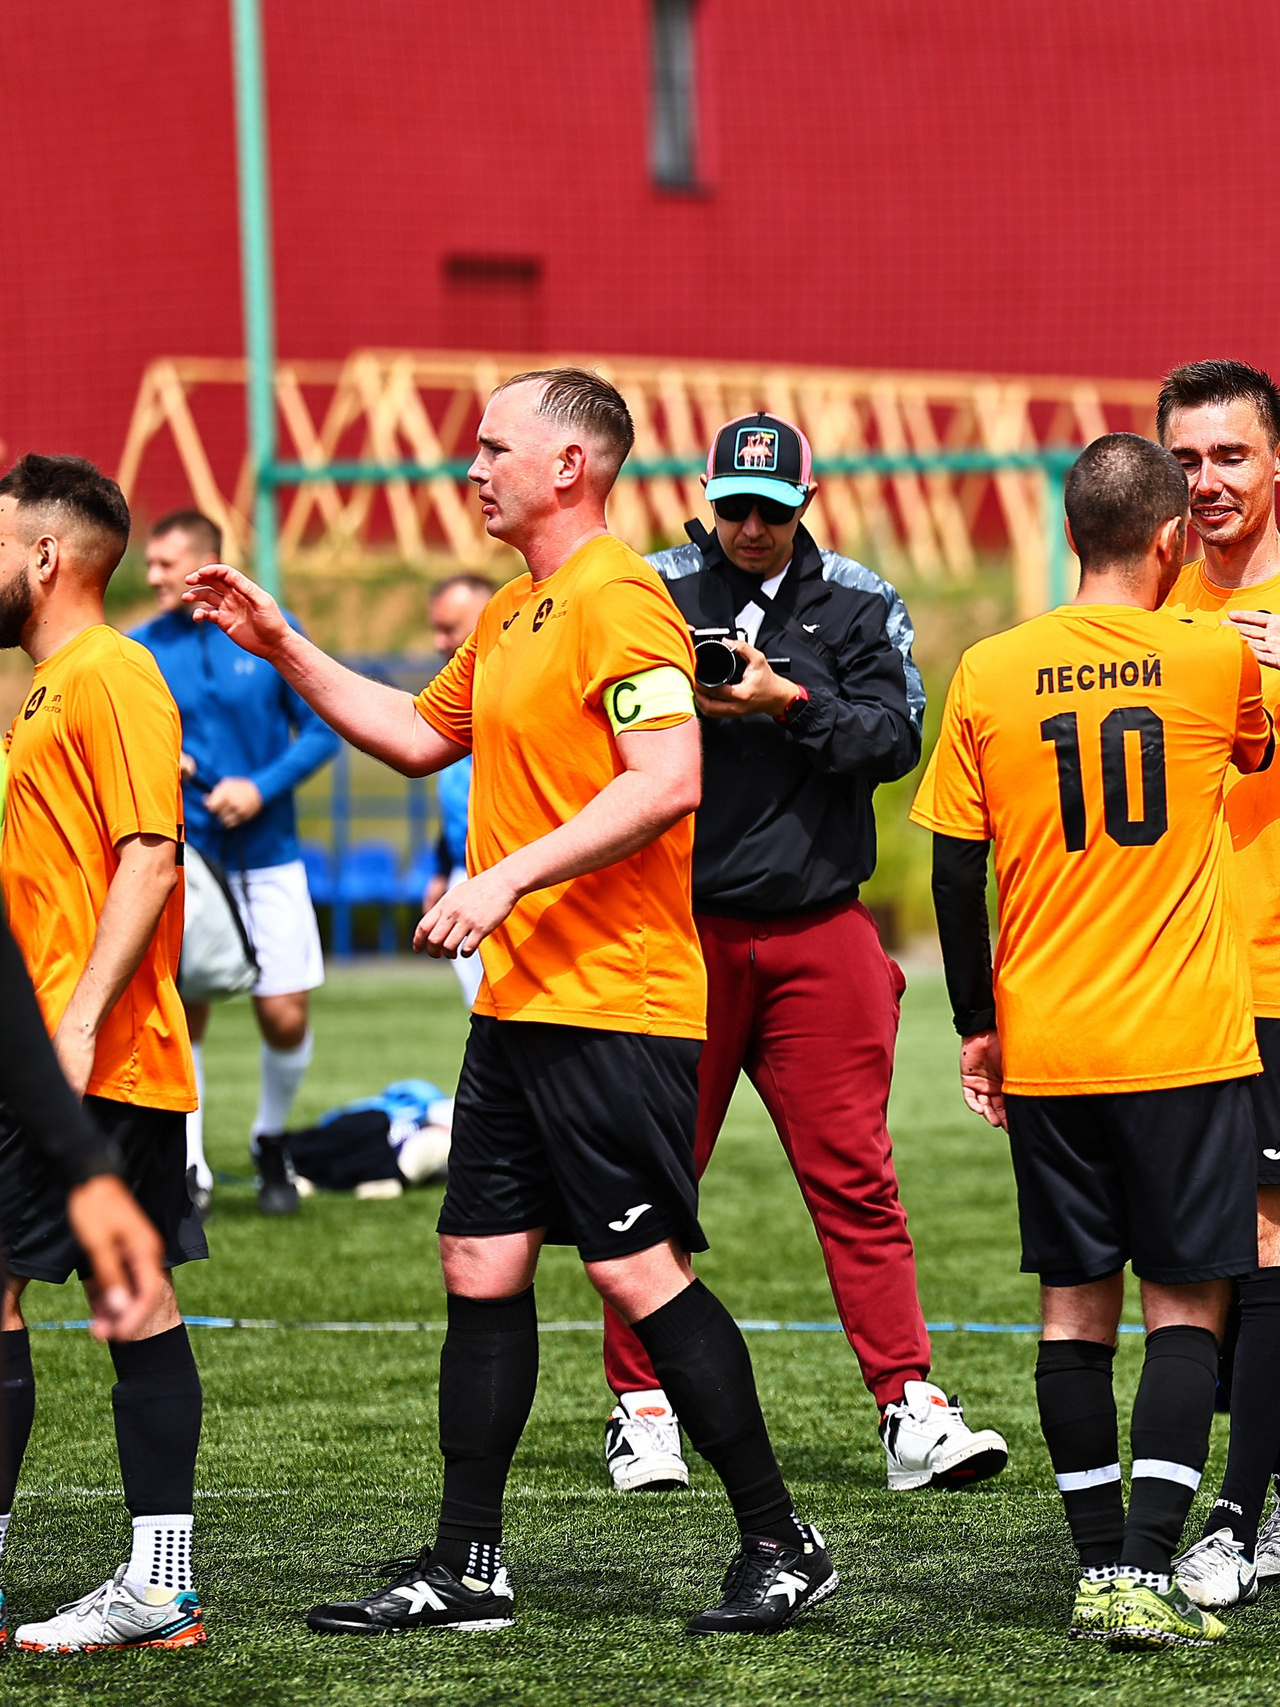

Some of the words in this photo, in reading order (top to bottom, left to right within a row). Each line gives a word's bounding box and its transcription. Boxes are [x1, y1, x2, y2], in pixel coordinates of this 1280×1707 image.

[1036, 653, 1161, 695] ЛЕСНОЙ
[613, 681, 641, 724] C
[1040, 706, 1168, 853] 10
